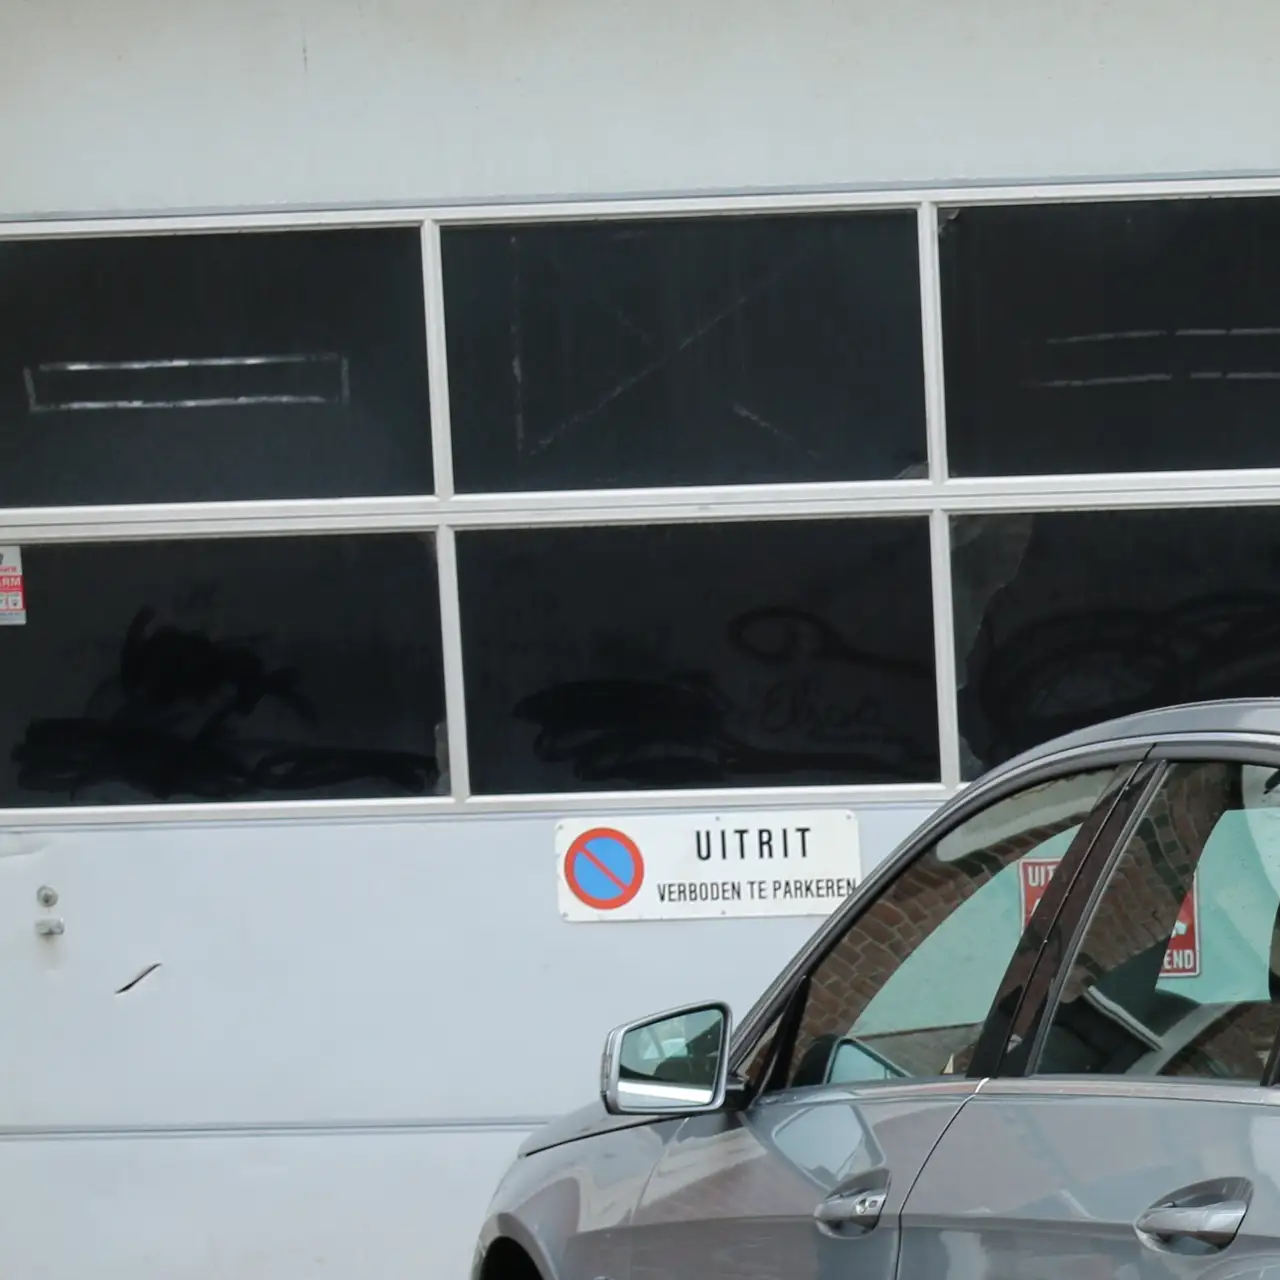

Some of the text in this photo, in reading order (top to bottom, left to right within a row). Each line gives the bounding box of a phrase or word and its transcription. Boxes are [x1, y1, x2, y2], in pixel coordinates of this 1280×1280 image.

[695, 827, 812, 861] UITRIT
[657, 877, 857, 902] VERBODEN TE PARKEREN
